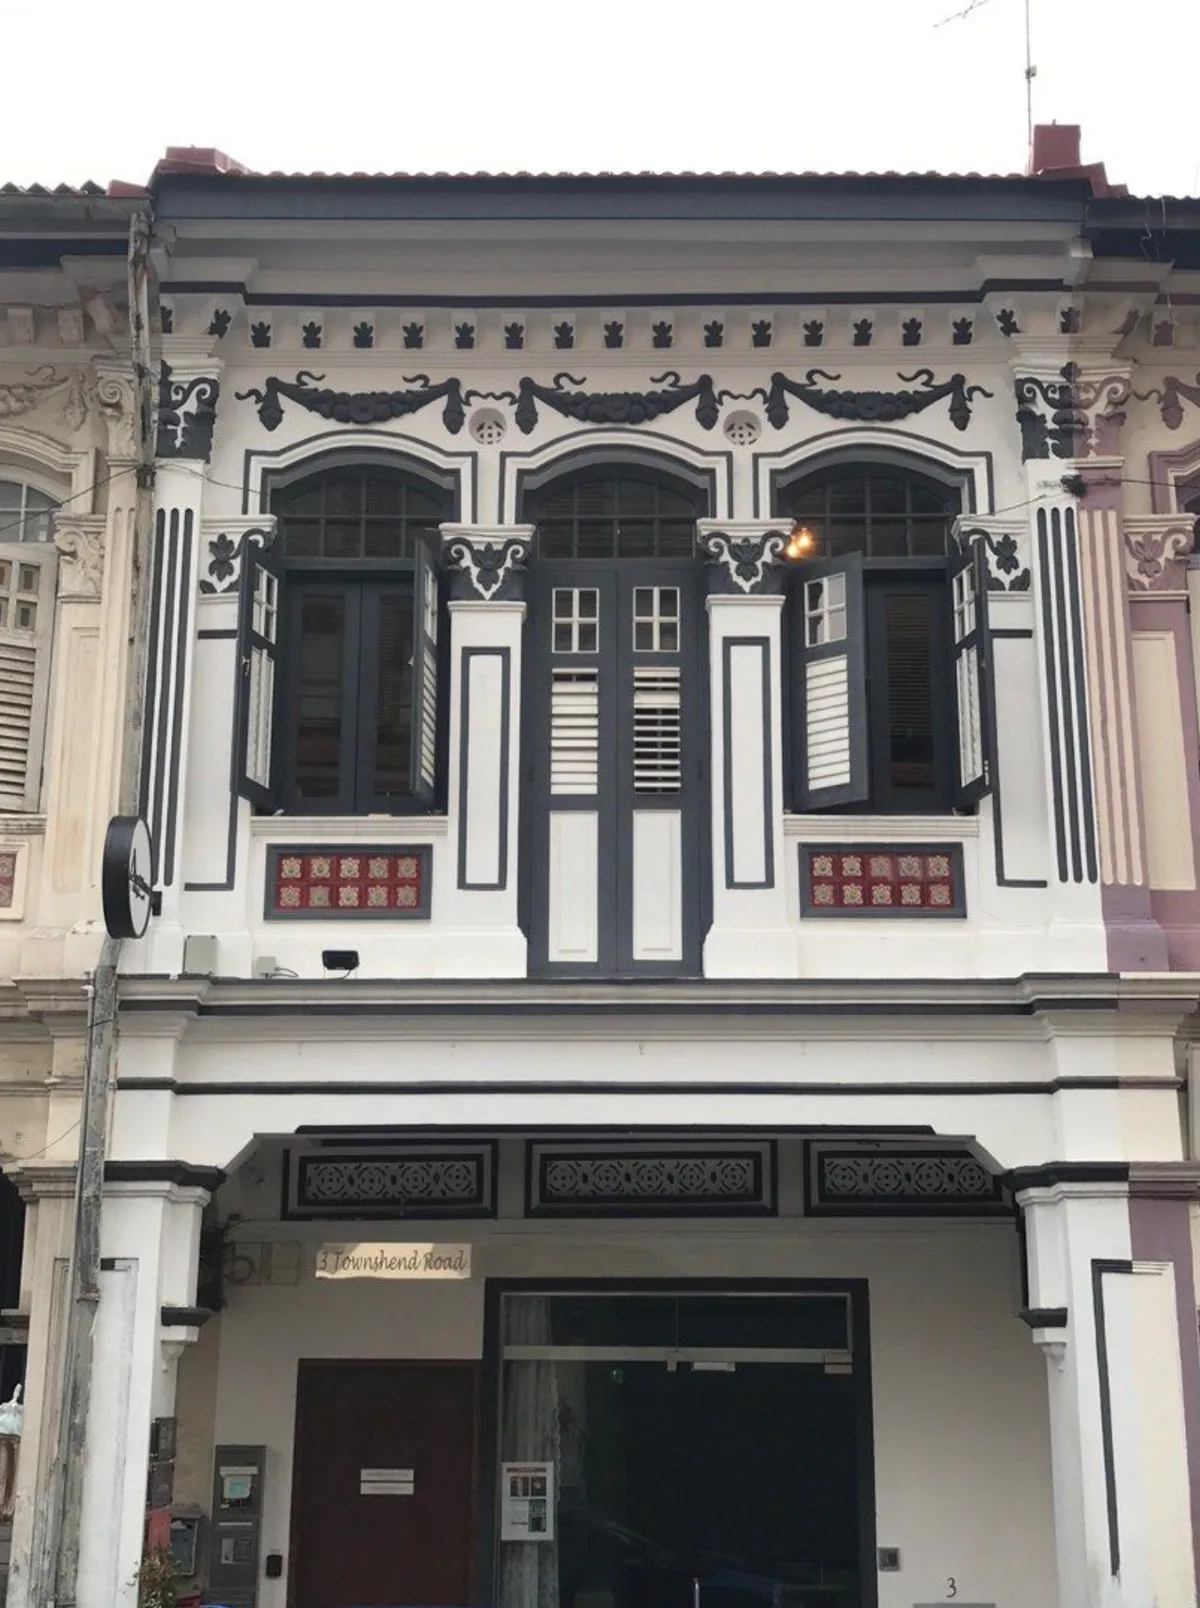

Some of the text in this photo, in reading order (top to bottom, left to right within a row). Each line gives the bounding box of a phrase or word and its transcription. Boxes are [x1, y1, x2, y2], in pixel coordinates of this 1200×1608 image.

[319, 1250, 467, 1272] 3 Townshend Road
[946, 1576, 957, 1598] 3
